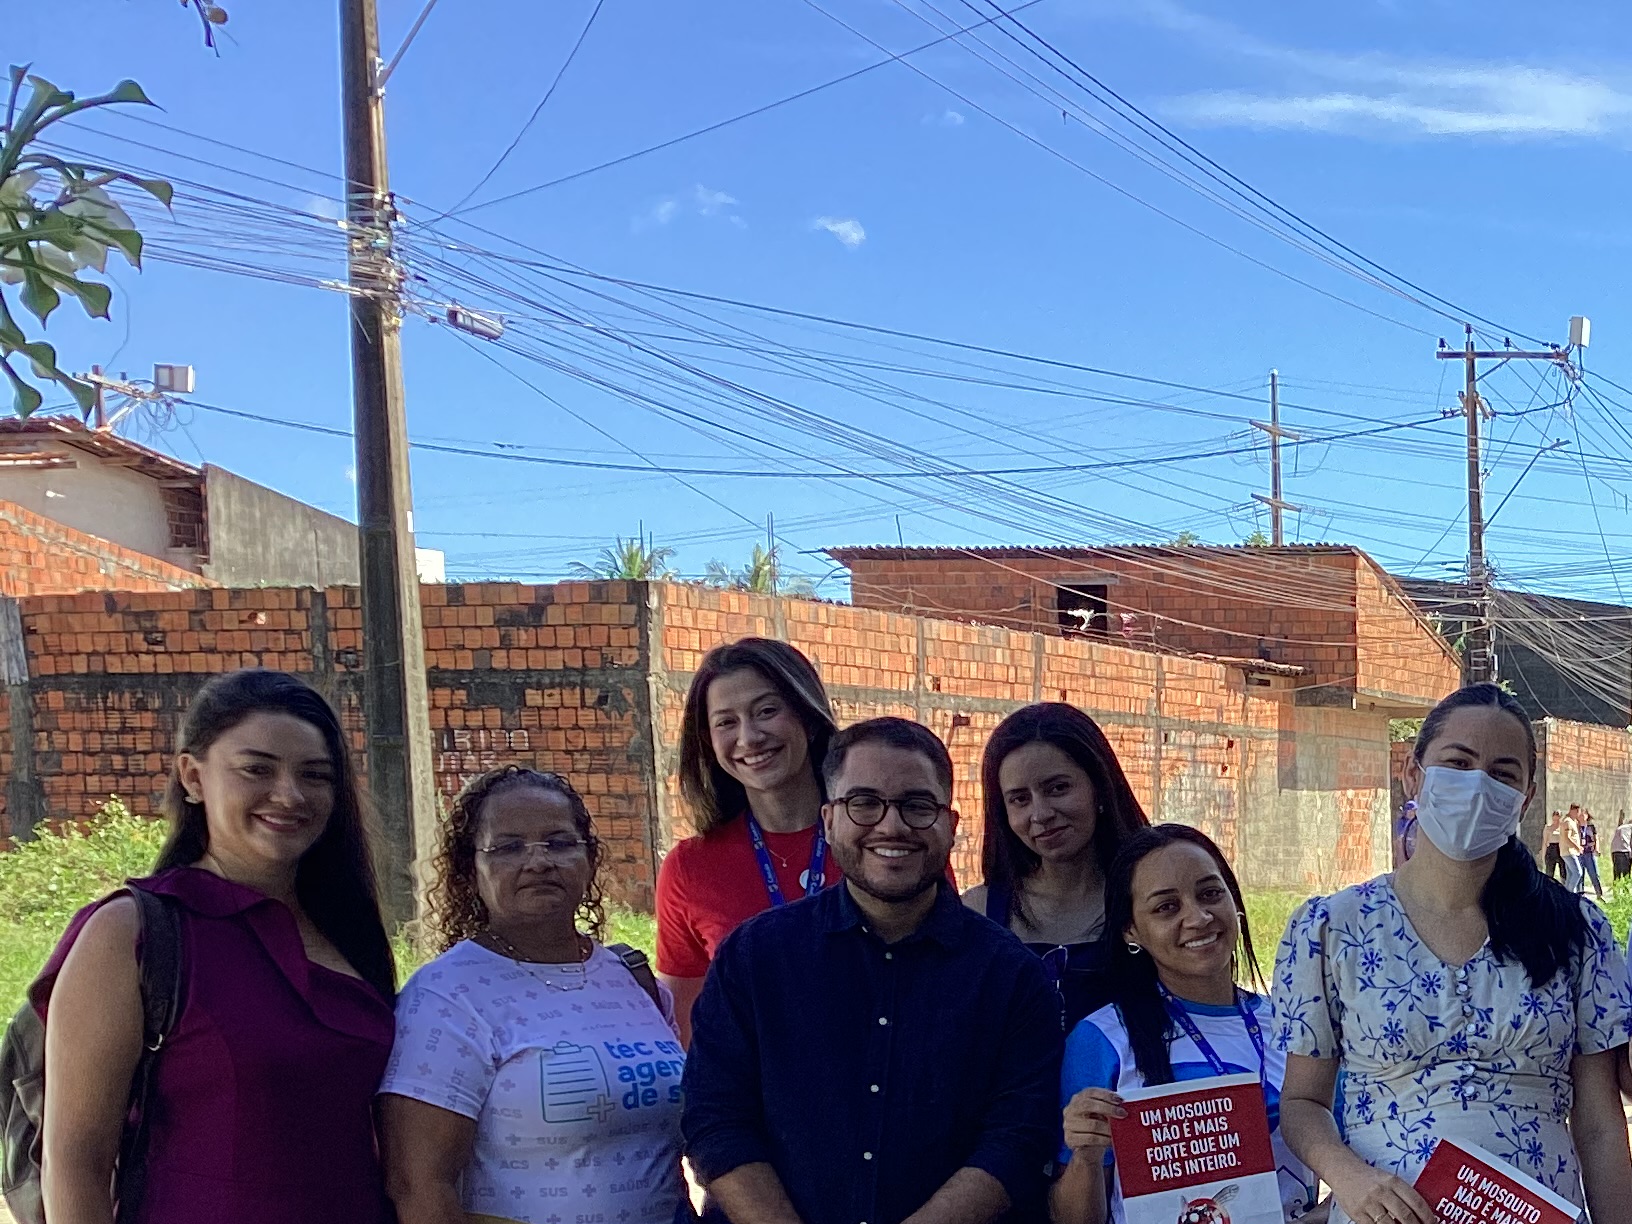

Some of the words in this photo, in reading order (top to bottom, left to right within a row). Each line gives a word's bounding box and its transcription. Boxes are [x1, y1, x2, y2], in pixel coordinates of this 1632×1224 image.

[426, 1028, 442, 1052] SUS
[623, 1083, 658, 1110] de
[1140, 1109, 1162, 1126] UM
[1165, 1098, 1232, 1122] MOSQUITO
[1152, 1123, 1180, 1143] NÃO
[1183, 1119, 1191, 1138] É
[1194, 1116, 1228, 1136] MAIS
[1146, 1142, 1188, 1164] FORTE
[1190, 1137, 1216, 1155] QUE
[1219, 1132, 1240, 1150] UM
[500, 1160, 530, 1170] ACS
[1152, 1160, 1182, 1181] PAÍS
[1184, 1152, 1242, 1175] INTEIRO.
[539, 1187, 568, 1198] SUS
[1453, 1186, 1482, 1210] NÃO
[1481, 1200, 1494, 1216] É
[1457, 1164, 1480, 1186] UM
[1478, 1178, 1541, 1224] MOSQUITO
[576, 1213, 604, 1224] SUS
